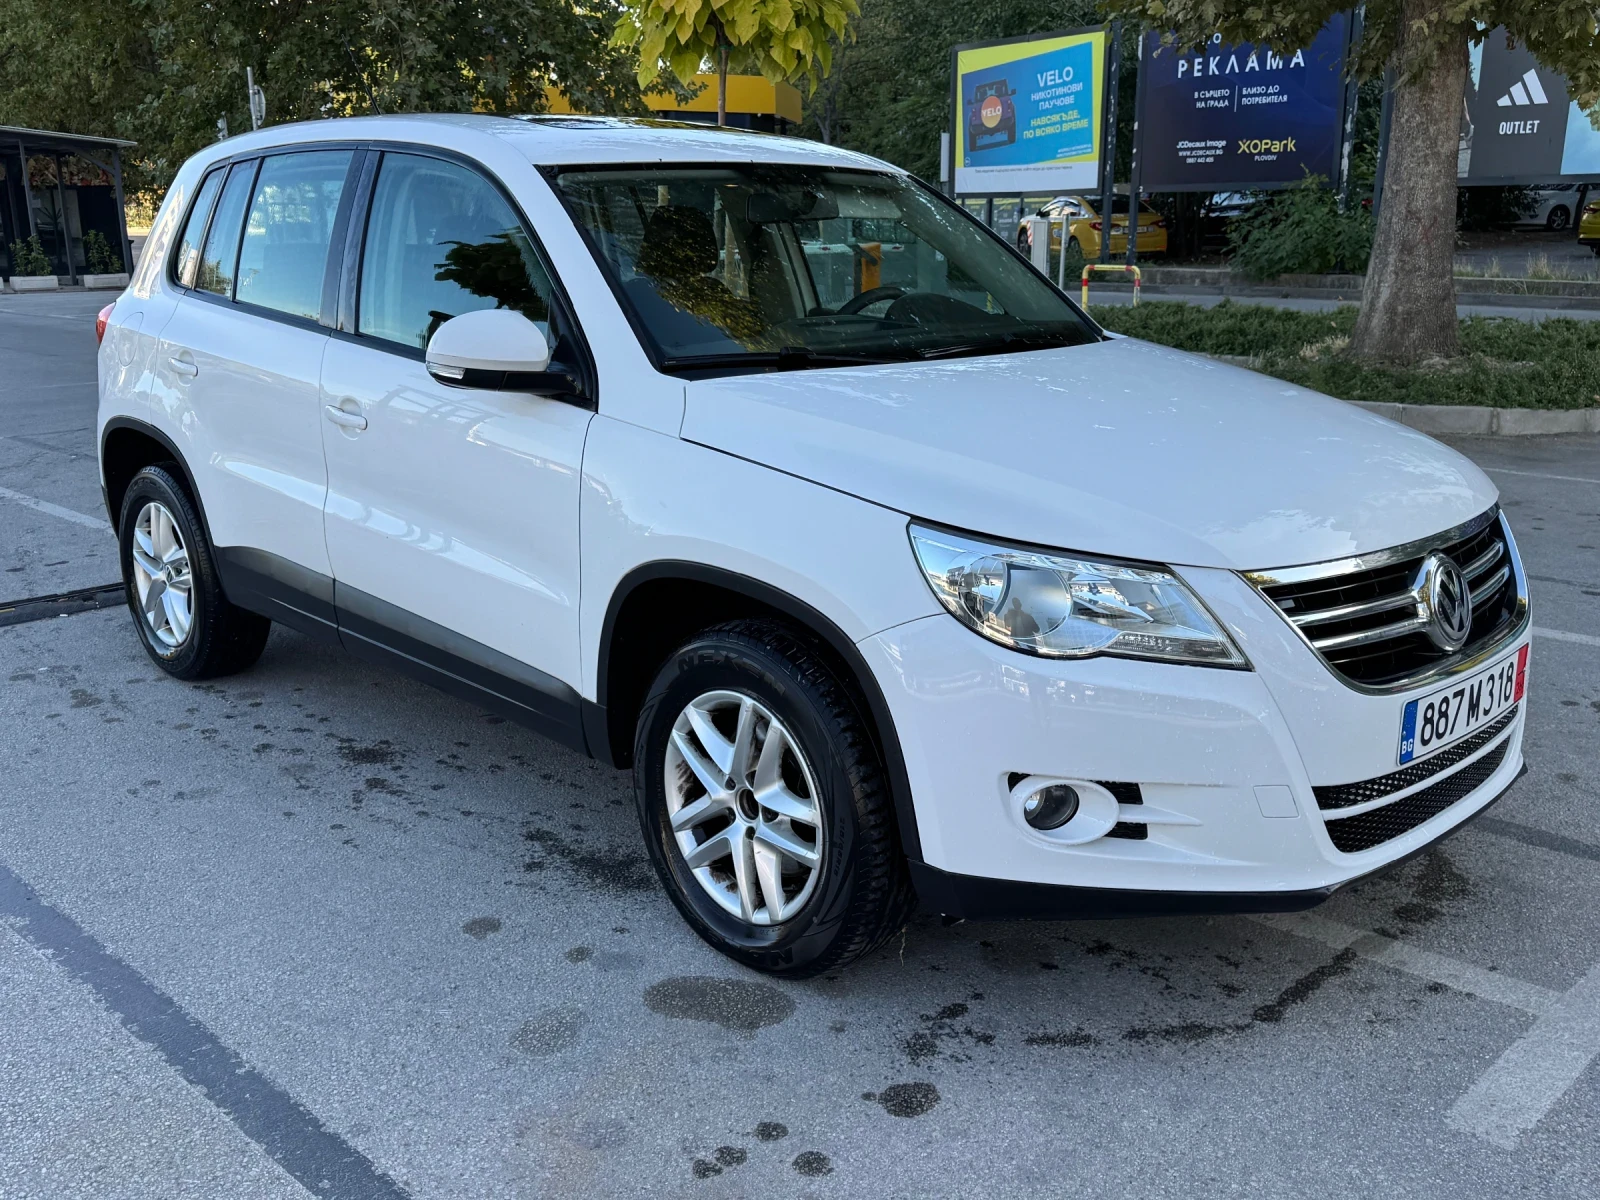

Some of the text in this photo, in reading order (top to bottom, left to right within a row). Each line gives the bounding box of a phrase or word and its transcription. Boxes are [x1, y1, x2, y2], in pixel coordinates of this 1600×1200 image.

[1177, 49, 1305, 78] РЕКЛАМА
[1037, 66, 1074, 87] VELO
[1031, 82, 1083, 101] НИКОТИНОВИ
[1200, 89, 1230, 98] СЪРЦЕТО
[1242, 85, 1280, 95] БЛИЗО ДО
[1039, 95, 1075, 110] ПАУЧОВЕ
[1207, 99, 1229, 108] ГРАДА
[1242, 95, 1288, 105] ПОТРЕБИТЕЛЯ
[982, 105, 1002, 117] VELO
[1023, 118, 1089, 139] ПО ВСЯКО ВРЕМЕ
[1499, 120, 1540, 134] OUTLET
[1176, 140, 1205, 149] JCDecaux
[1420, 662, 1514, 746] 887M318
[1401, 738, 1414, 755] BG
